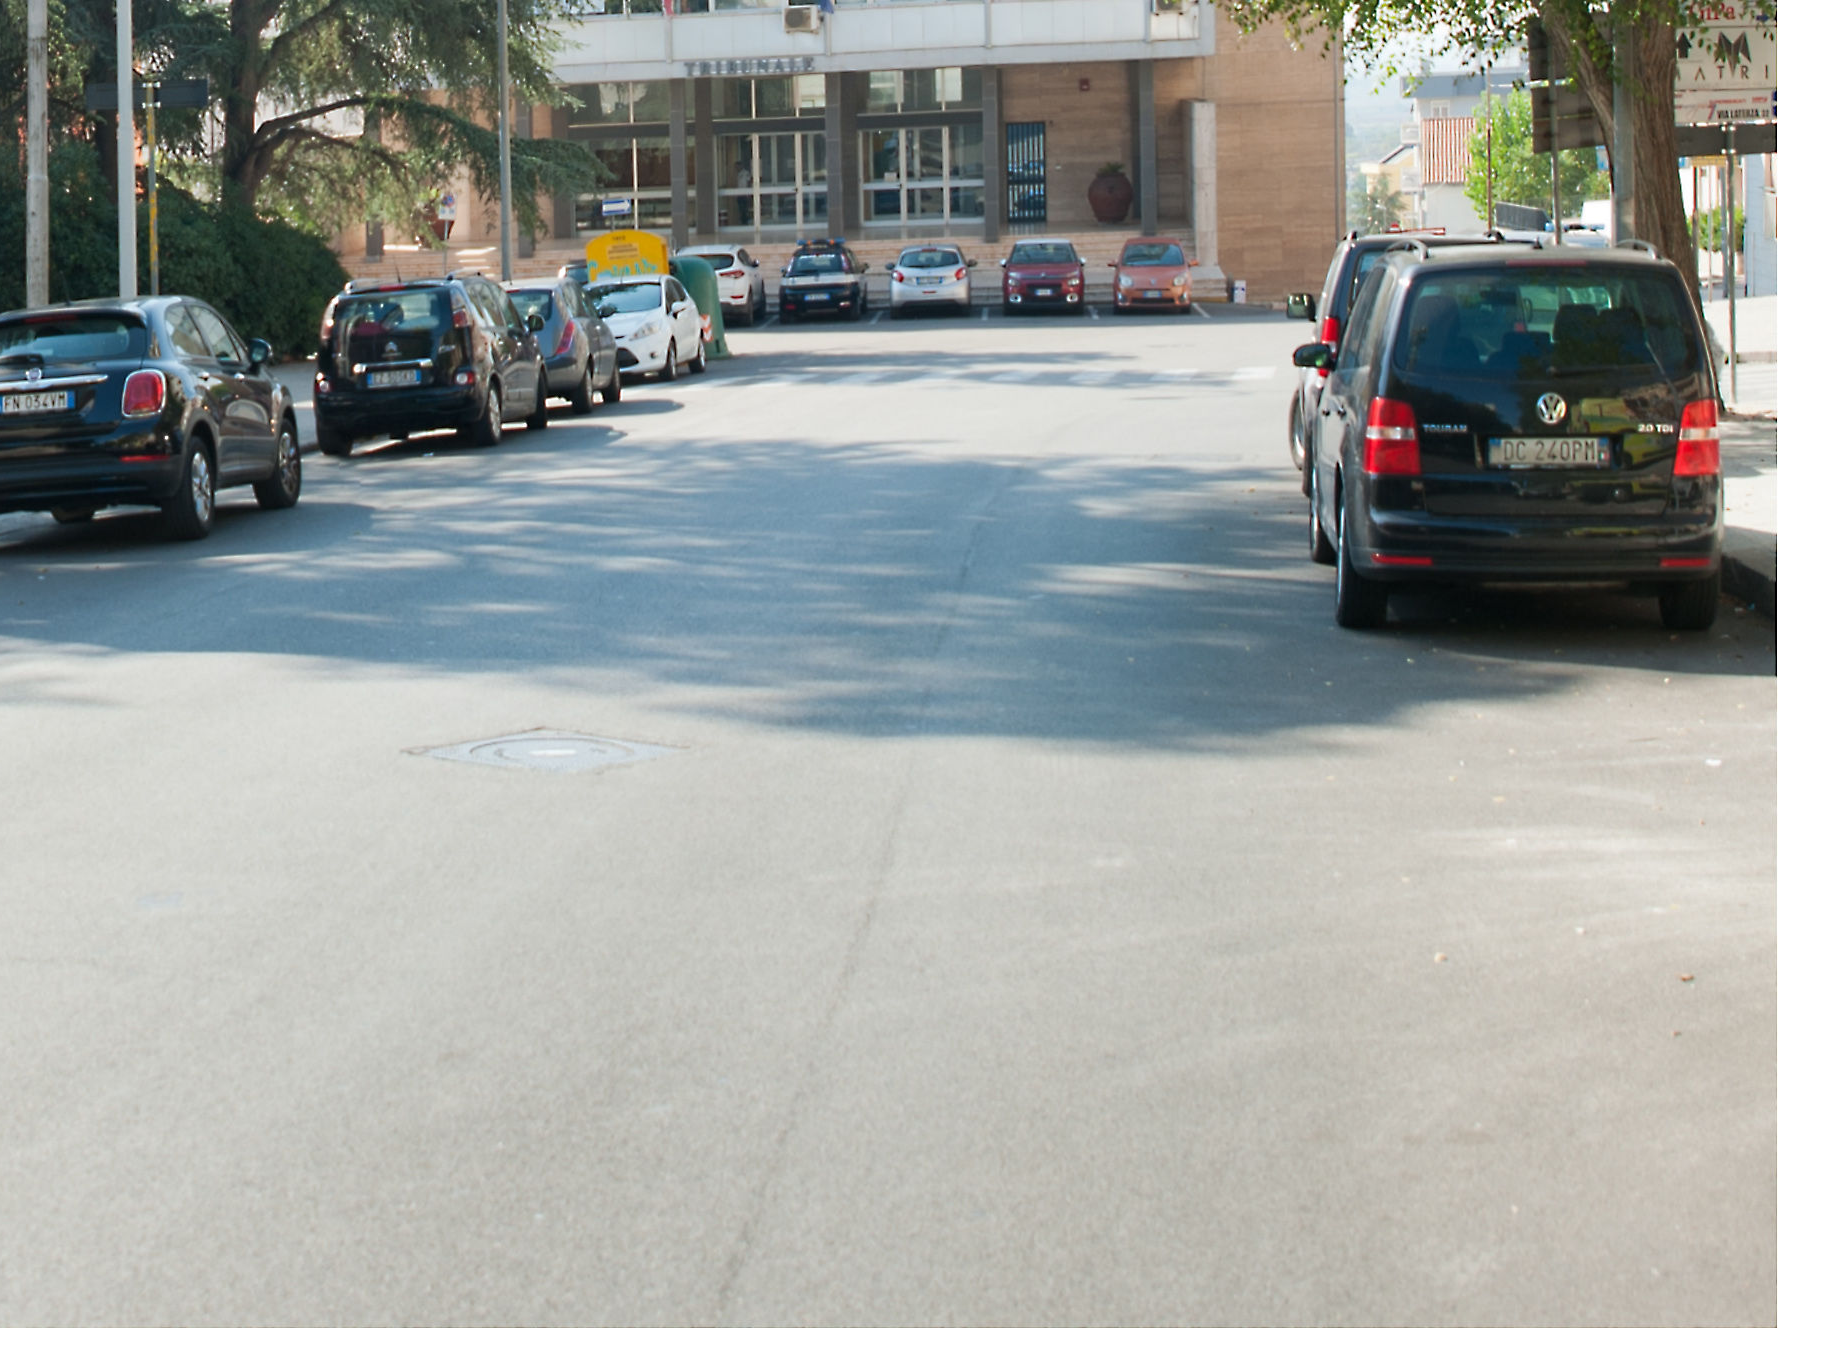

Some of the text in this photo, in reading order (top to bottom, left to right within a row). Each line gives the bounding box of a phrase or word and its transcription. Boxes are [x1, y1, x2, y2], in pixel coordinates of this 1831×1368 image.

[684, 57, 815, 76] TRIBUNALE
[4, 396, 20, 410] FN
[1504, 440, 1596, 461] DC 240PM
